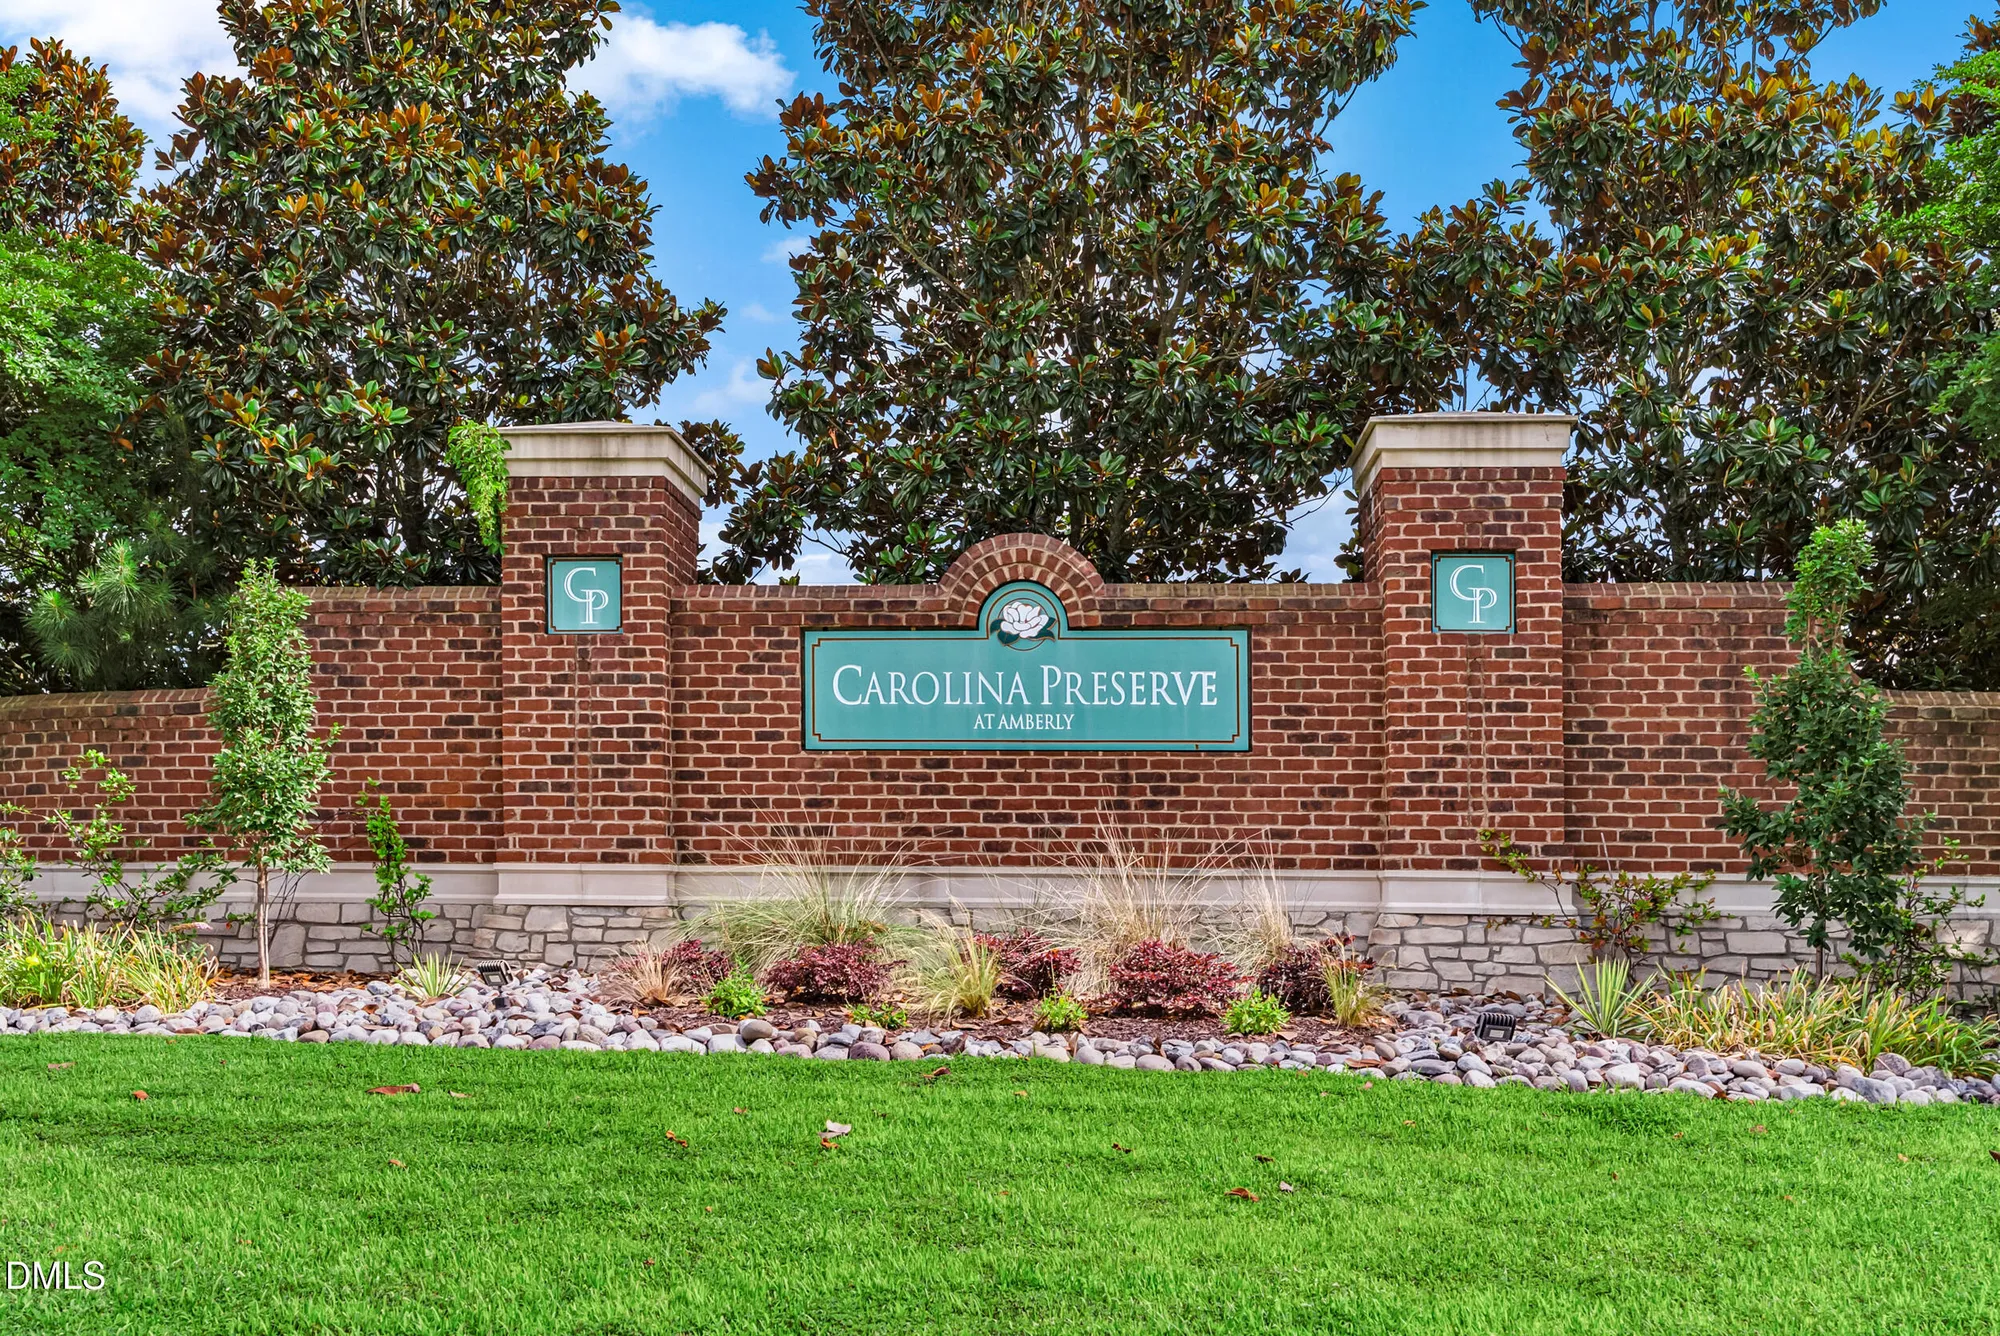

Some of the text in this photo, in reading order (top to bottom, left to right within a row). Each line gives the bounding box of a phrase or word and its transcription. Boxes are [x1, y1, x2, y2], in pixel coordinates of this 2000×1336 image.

[832, 664, 1218, 706] CAROLINA PRESERVE
[973, 713, 1075, 730] AT AMBERLY
